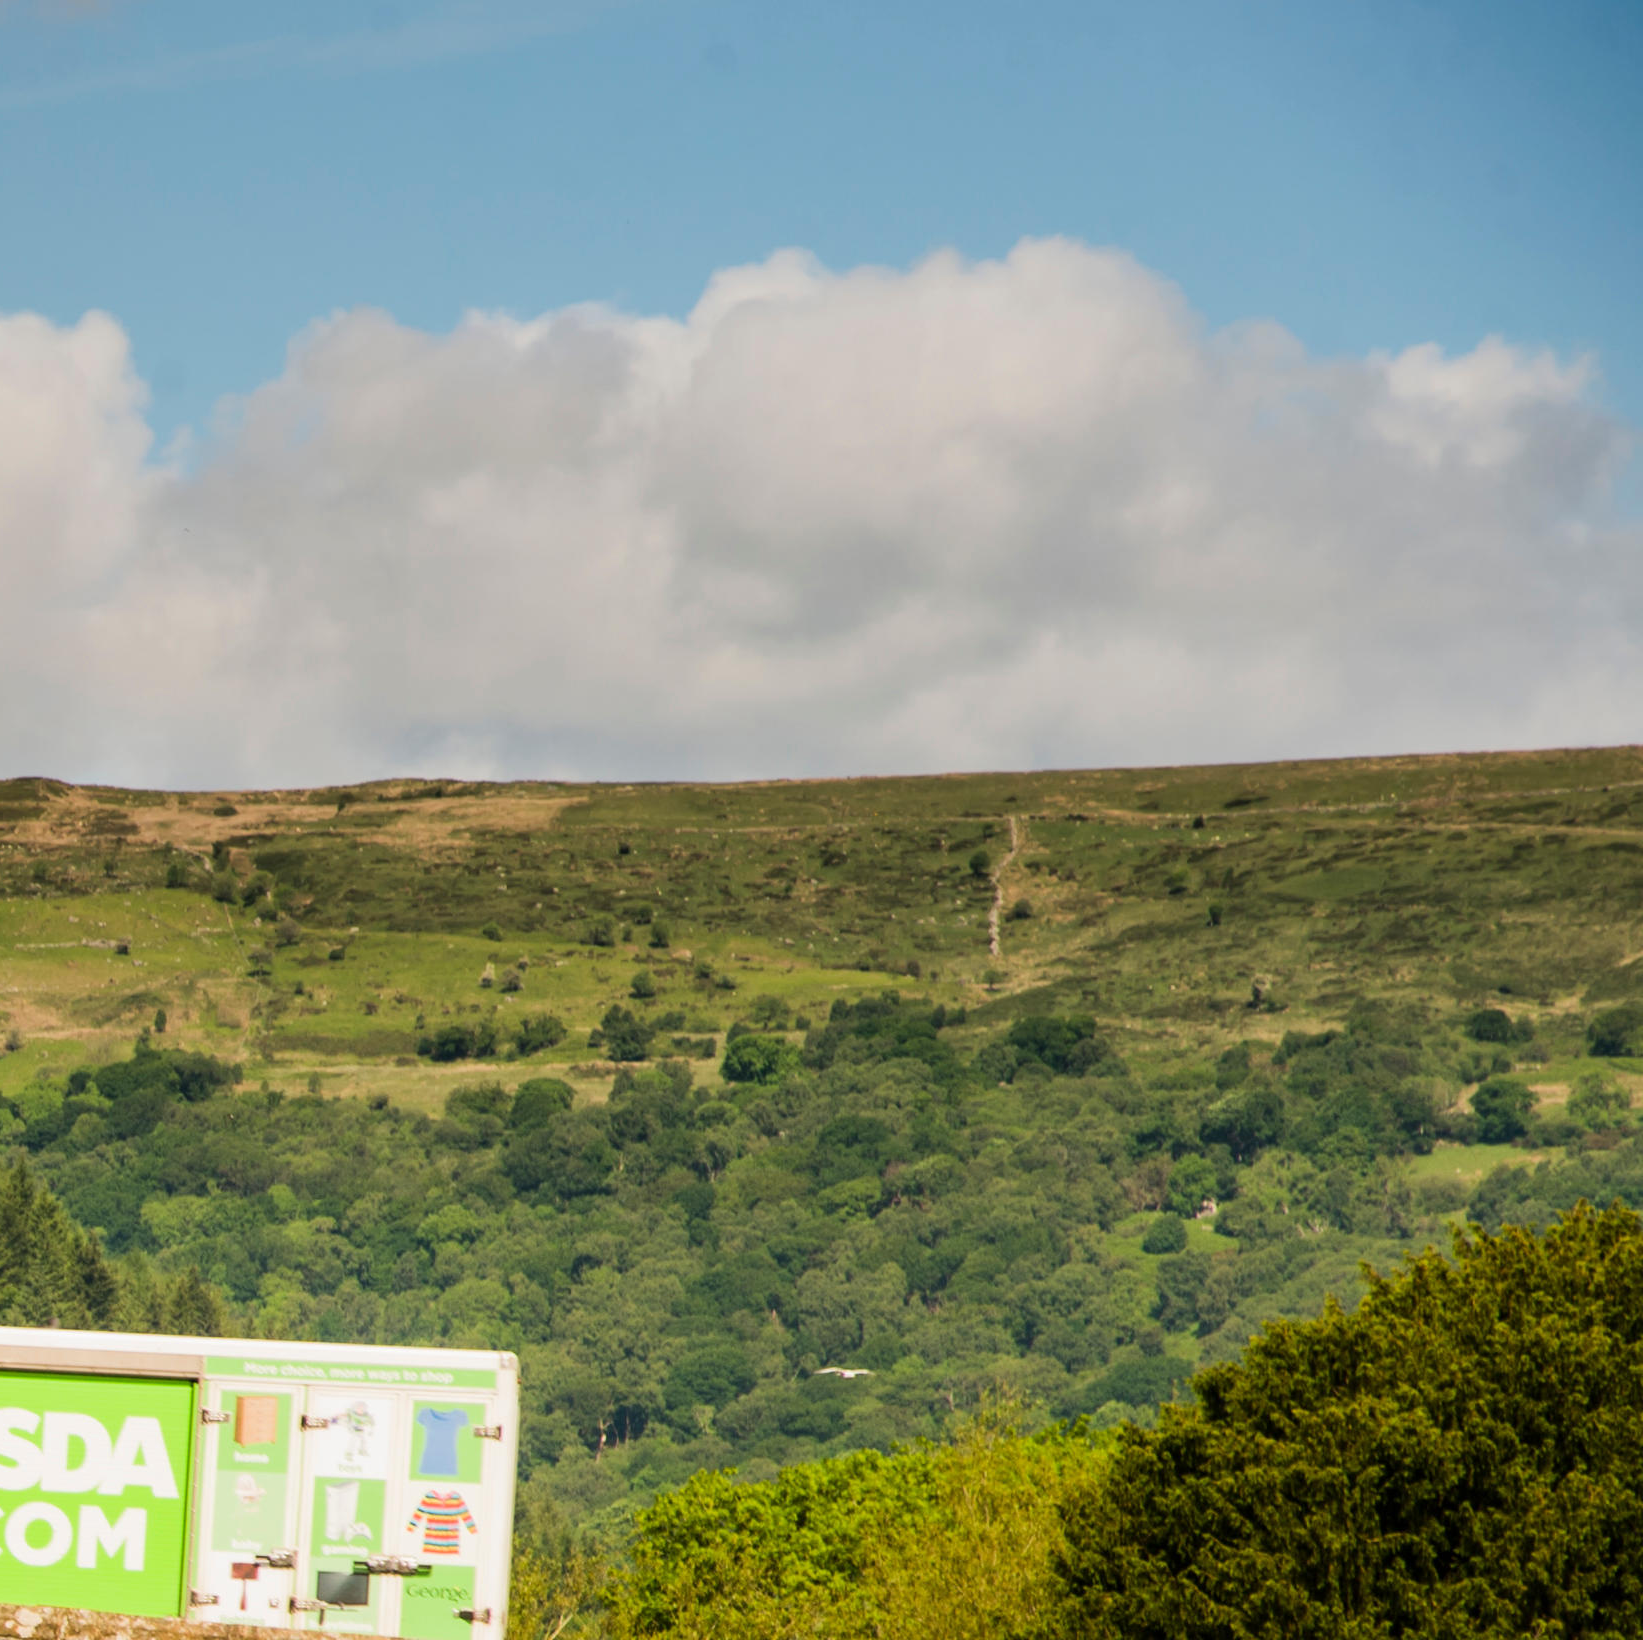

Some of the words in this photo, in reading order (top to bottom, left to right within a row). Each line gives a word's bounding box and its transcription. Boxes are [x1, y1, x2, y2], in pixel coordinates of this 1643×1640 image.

[243, 1361, 278, 1376] More
[329, 1367, 365, 1379] more
[367, 1369, 401, 1383] ways
[402, 1369, 419, 1382] to
[420, 1370, 455, 1385] shop
